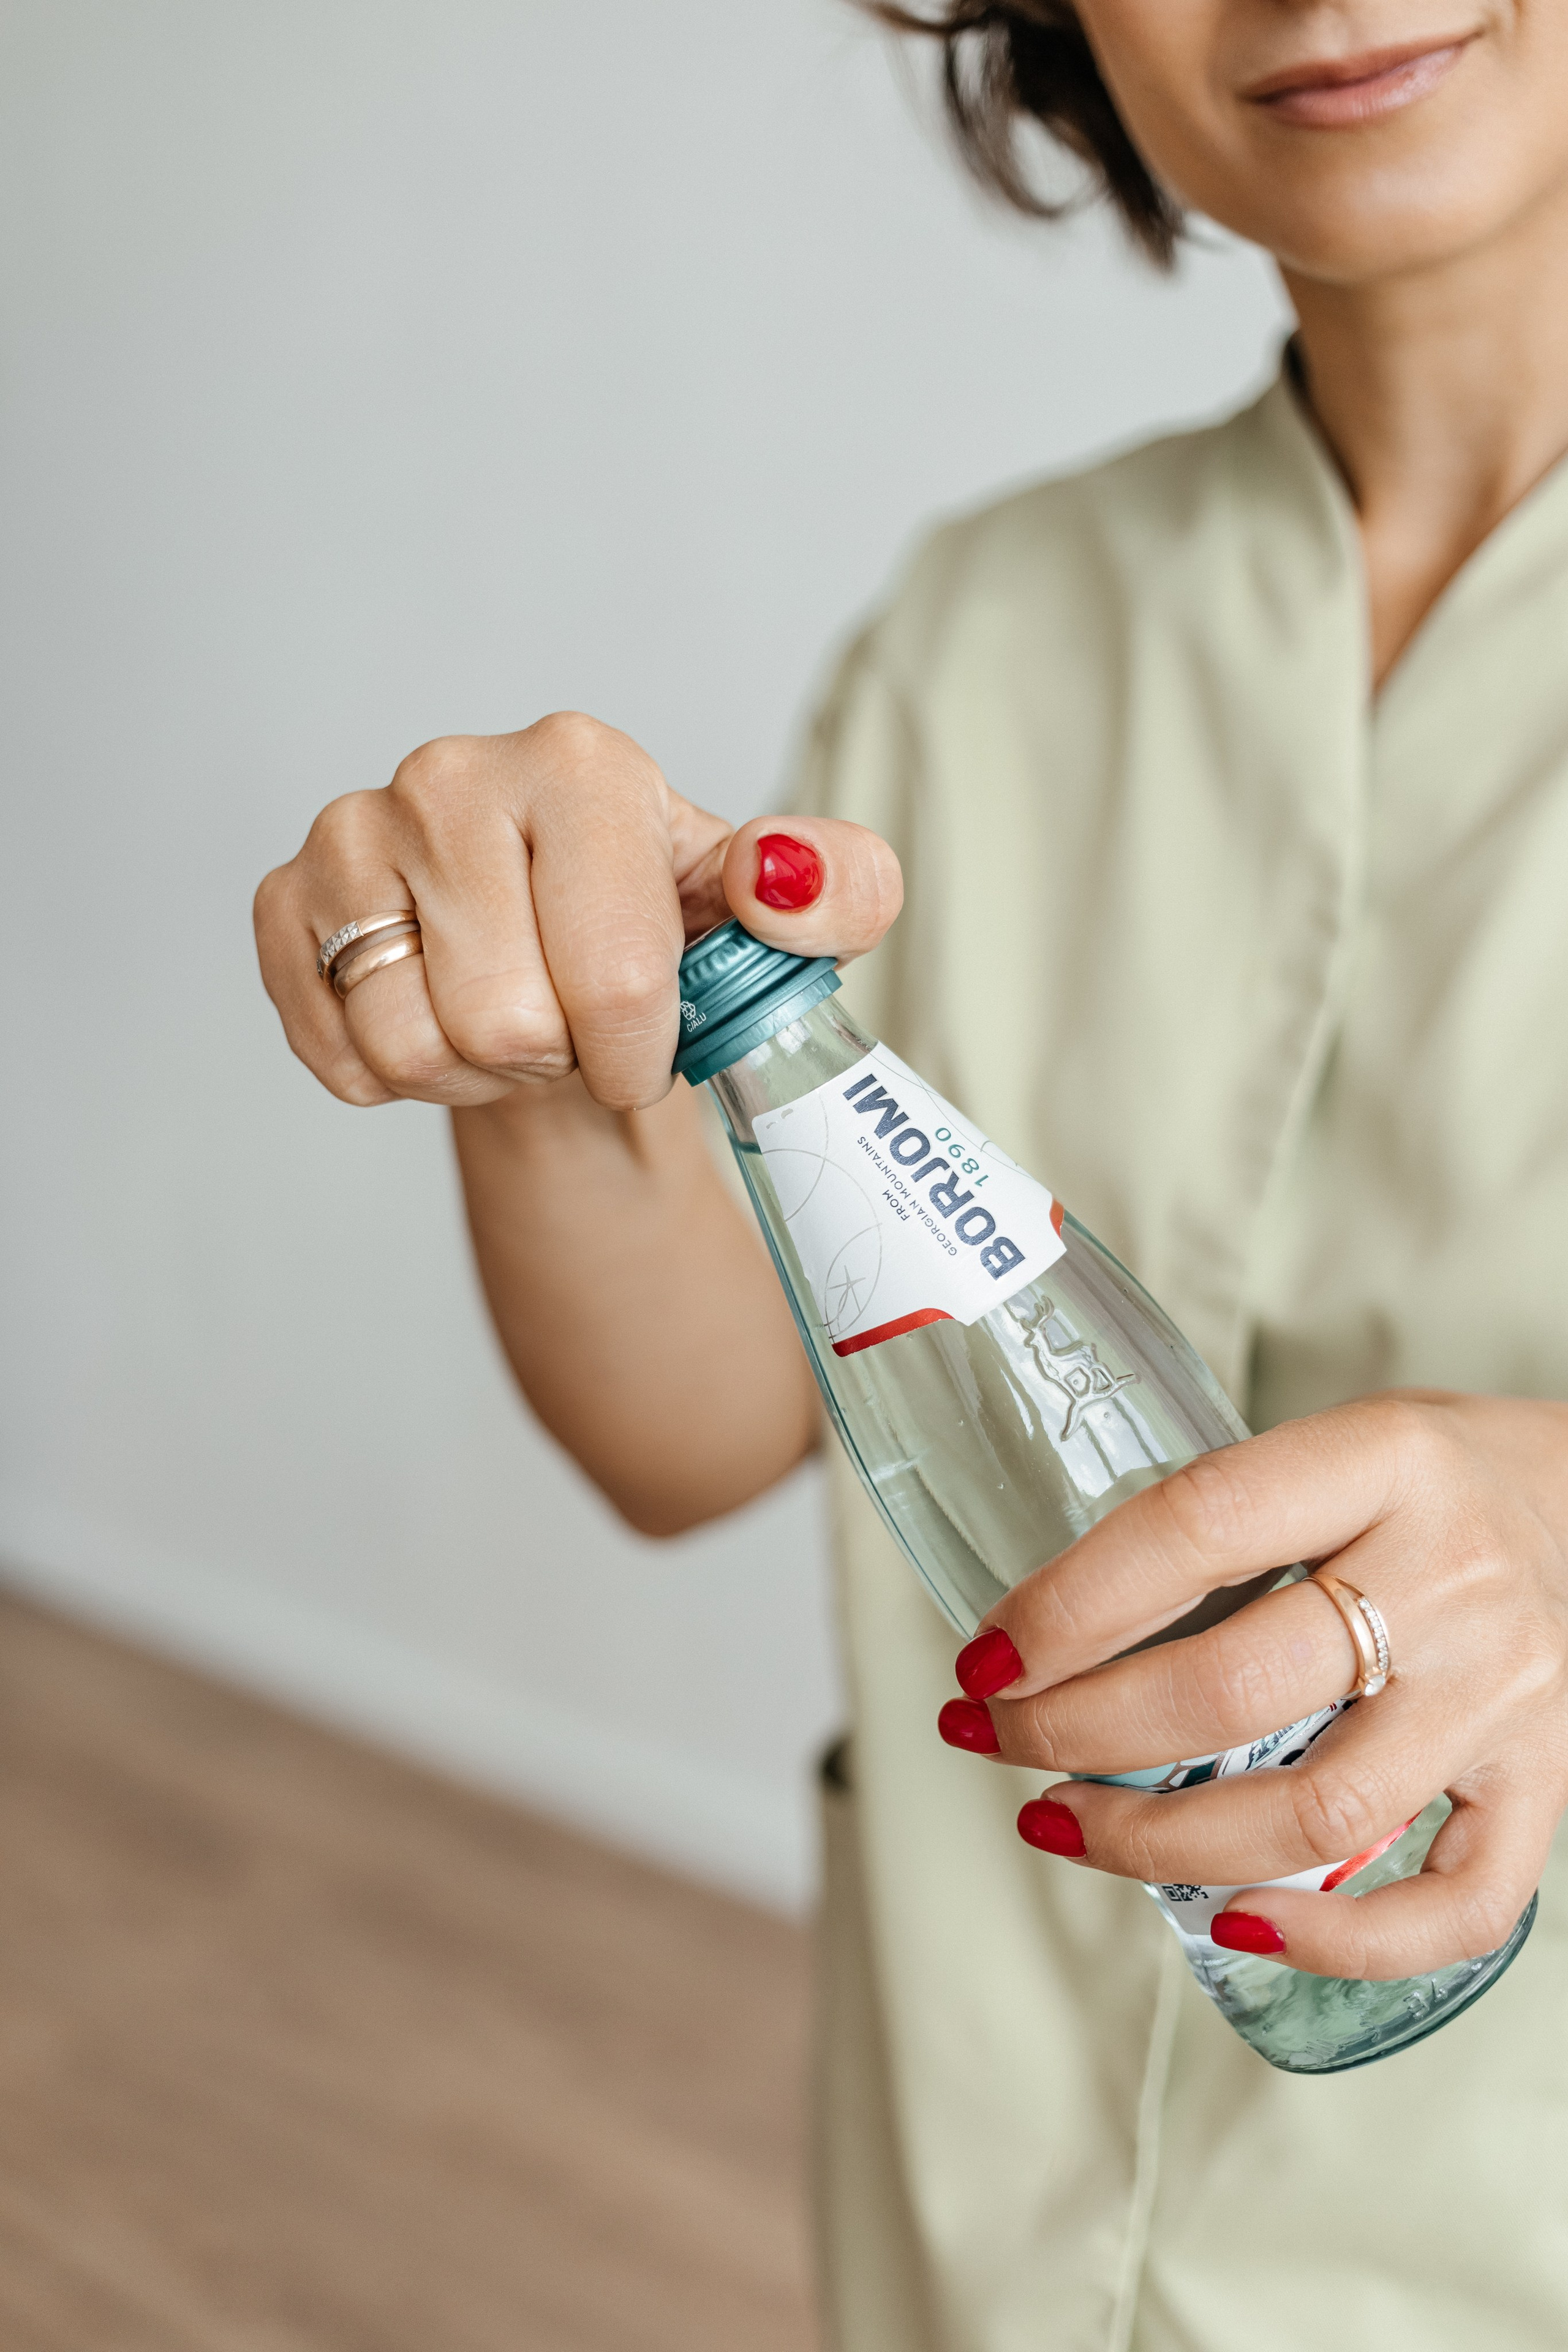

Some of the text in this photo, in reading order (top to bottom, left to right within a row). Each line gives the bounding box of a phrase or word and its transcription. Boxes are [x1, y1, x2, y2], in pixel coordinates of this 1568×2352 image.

[842, 1073, 1026, 1281] BORJOMI
[858, 1136, 957, 1256] GEORGIAN MOUNTAINS
[935, 1127, 989, 1187] 1890
[883, 1189, 910, 1221] FROM
